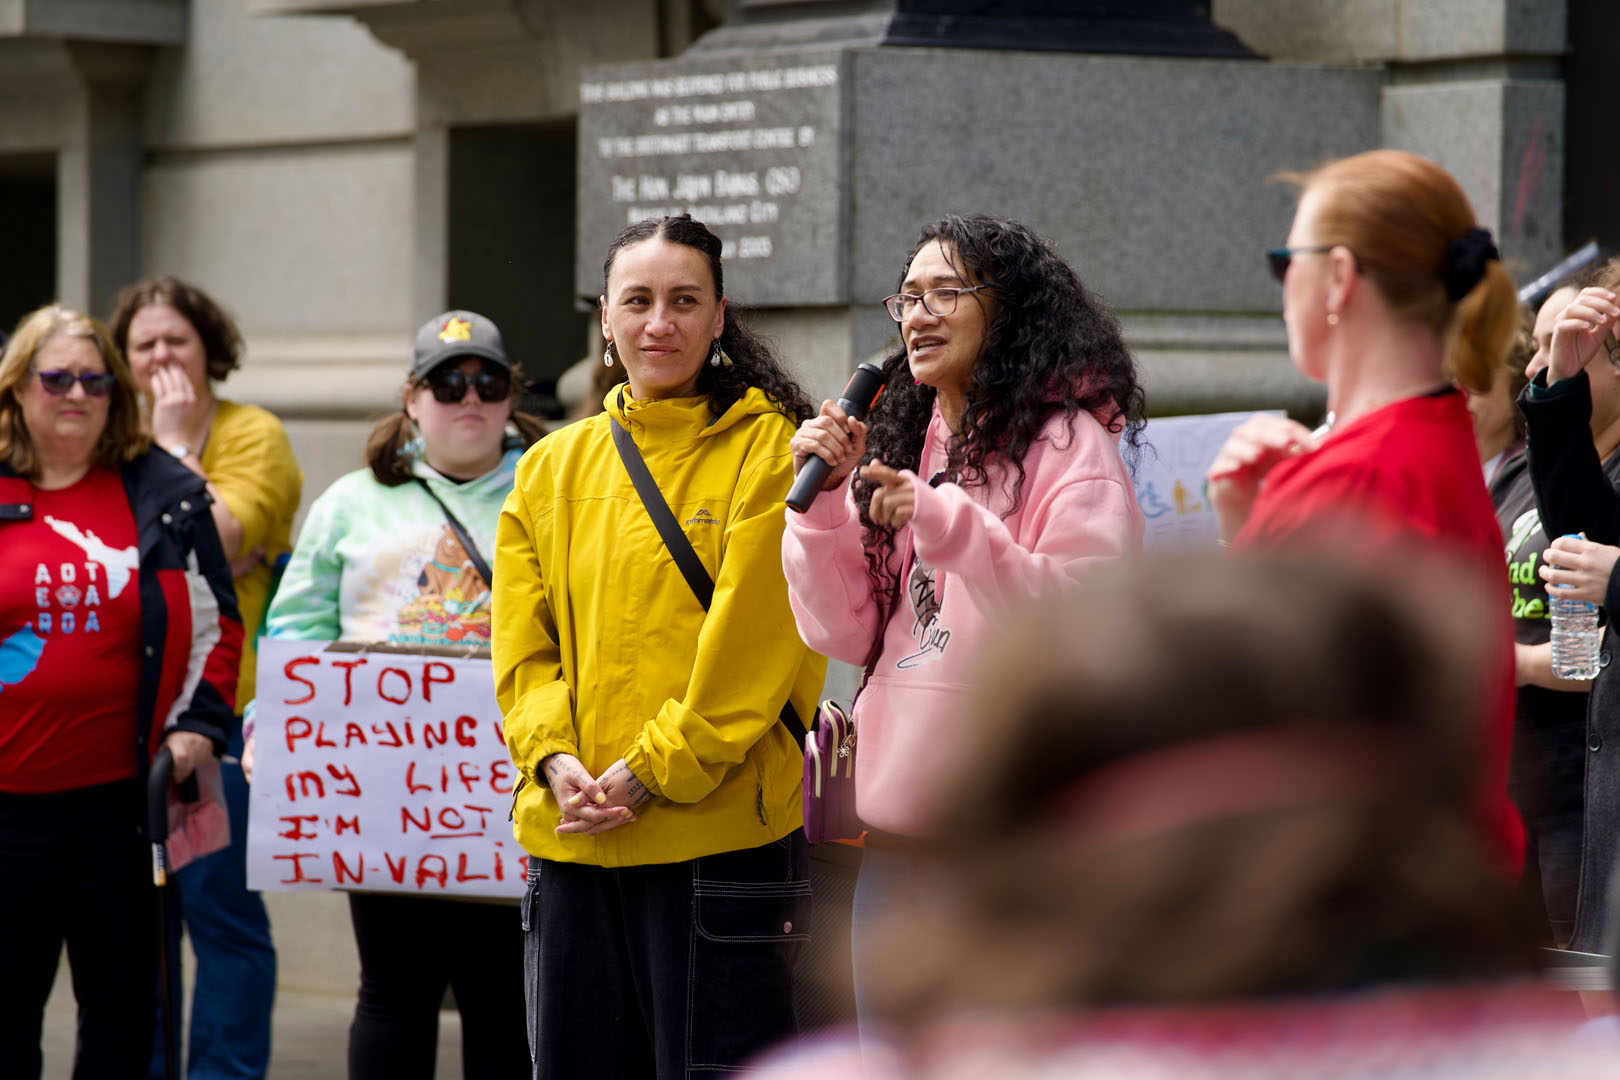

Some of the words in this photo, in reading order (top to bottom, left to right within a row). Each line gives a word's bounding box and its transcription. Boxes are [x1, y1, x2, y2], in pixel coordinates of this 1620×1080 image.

[35, 562, 99, 584] AOT
[283, 656, 455, 706] STOP
[285, 715, 478, 753] PLAYING
[406, 759, 513, 795] LIFE
[278, 814, 361, 841] I'M
[402, 804, 494, 839] NOT
